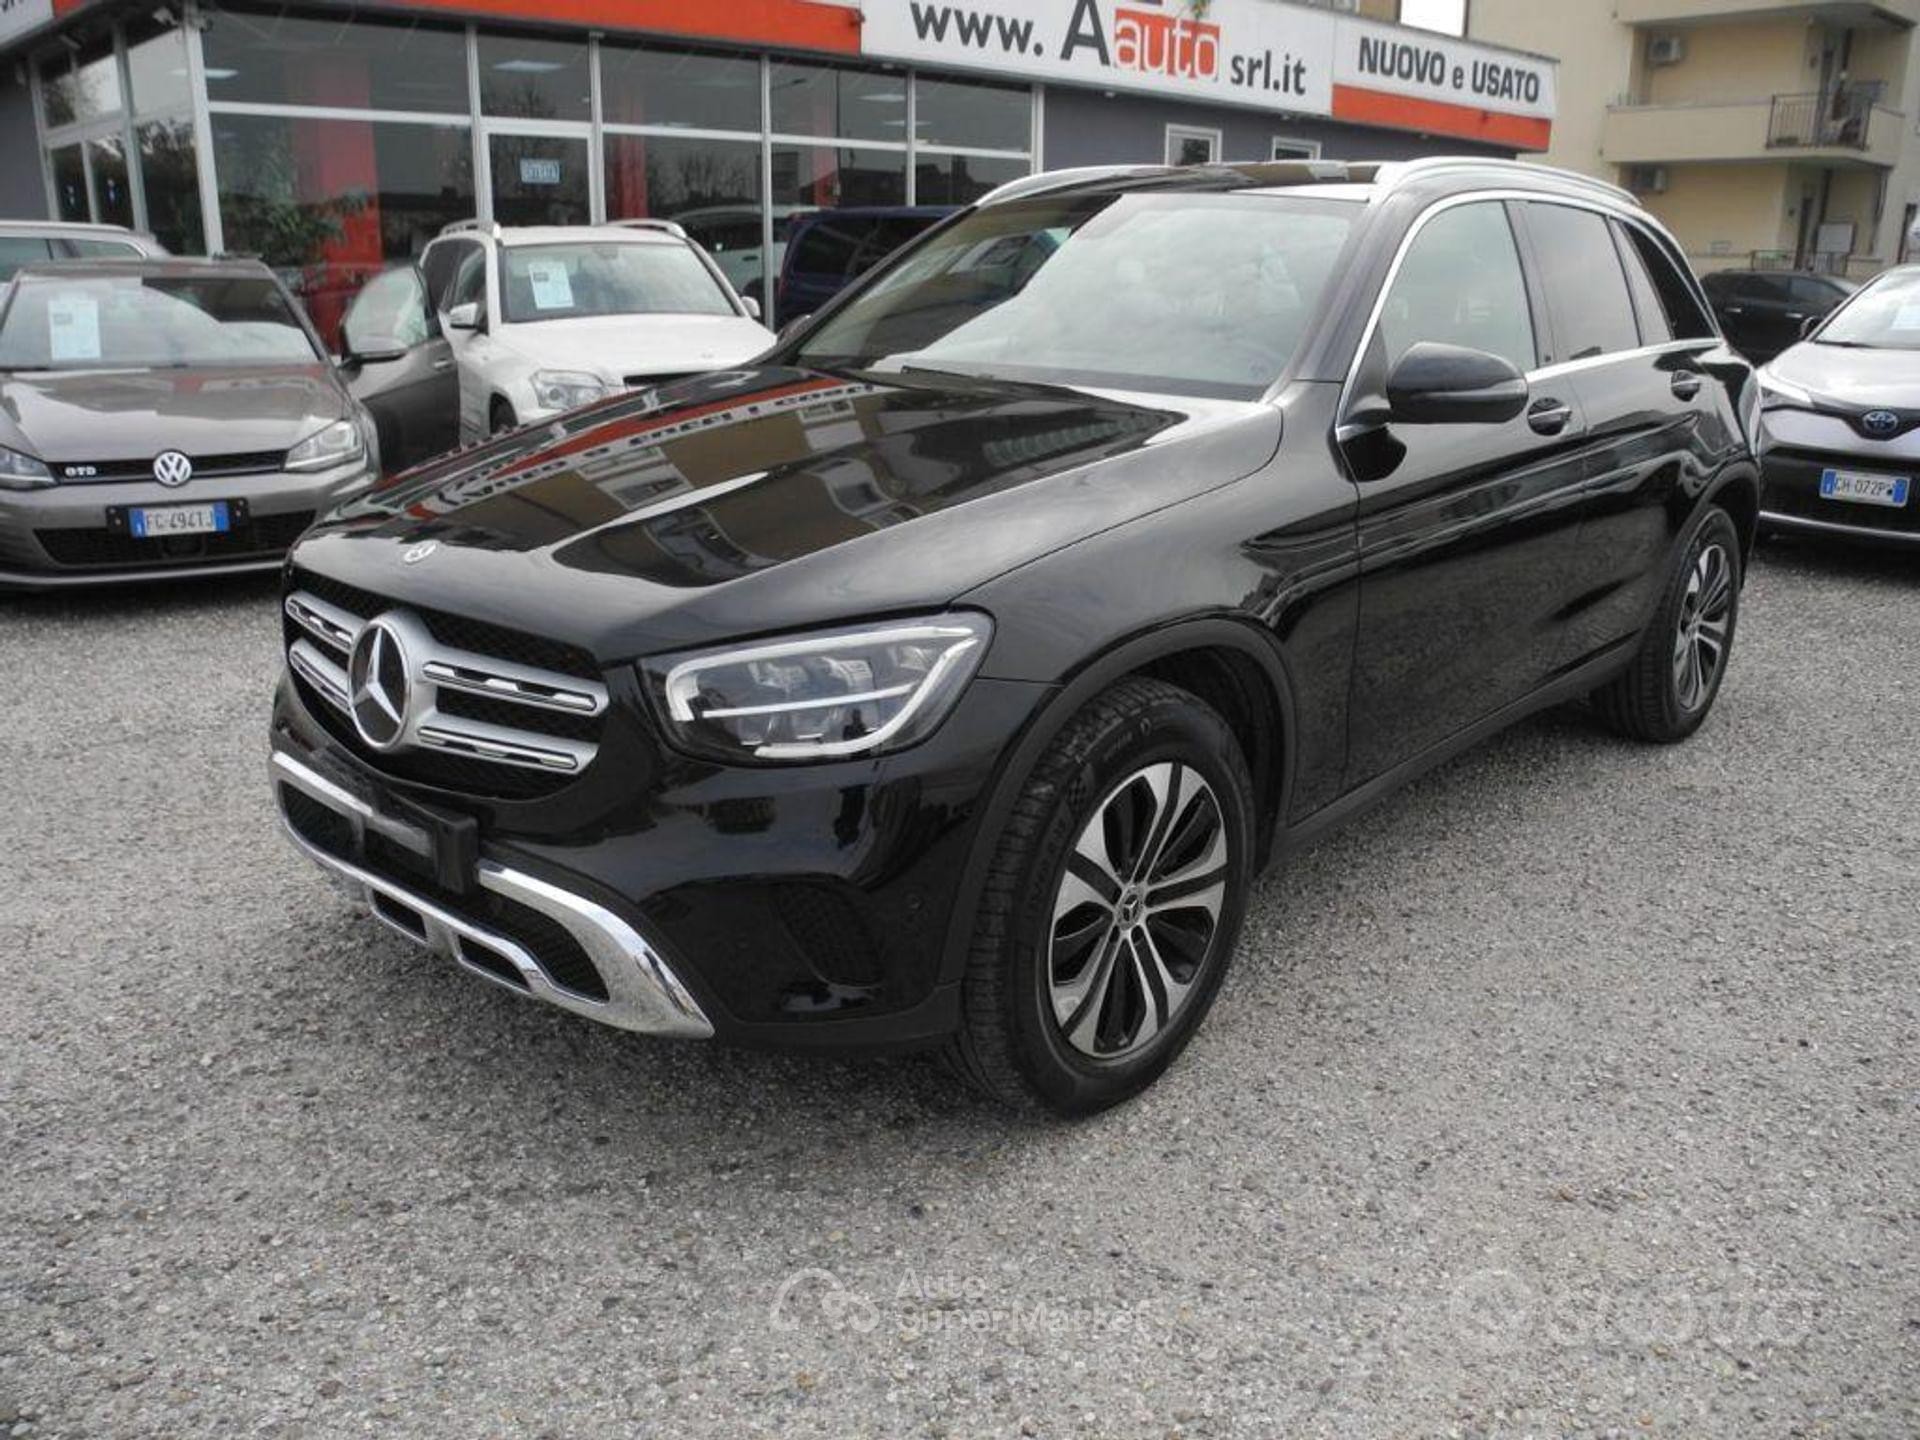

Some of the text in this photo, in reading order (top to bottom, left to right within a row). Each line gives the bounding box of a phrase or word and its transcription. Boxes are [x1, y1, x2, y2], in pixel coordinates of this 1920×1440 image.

[910, 2, 1044, 57] www.
[1231, 50, 1307, 96] srl.it
[1358, 36, 1541, 104] NUOVO e USATO
